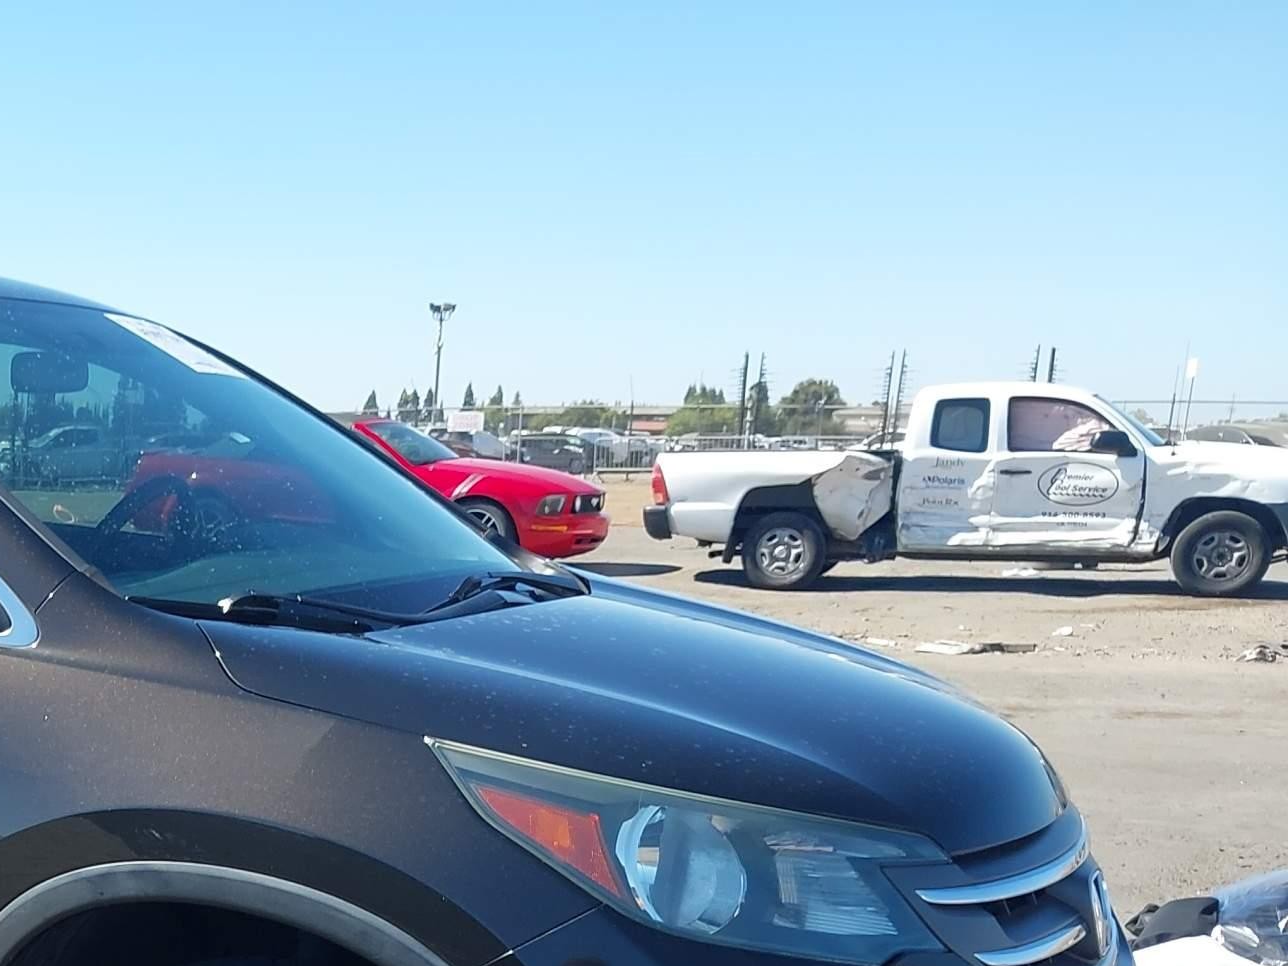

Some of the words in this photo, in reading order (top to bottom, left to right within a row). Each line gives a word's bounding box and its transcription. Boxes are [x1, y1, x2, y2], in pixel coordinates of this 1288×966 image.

[932, 475, 965, 485] Polaris
[1050, 468, 1095, 483] Premier
[1072, 484, 1109, 493] Service
